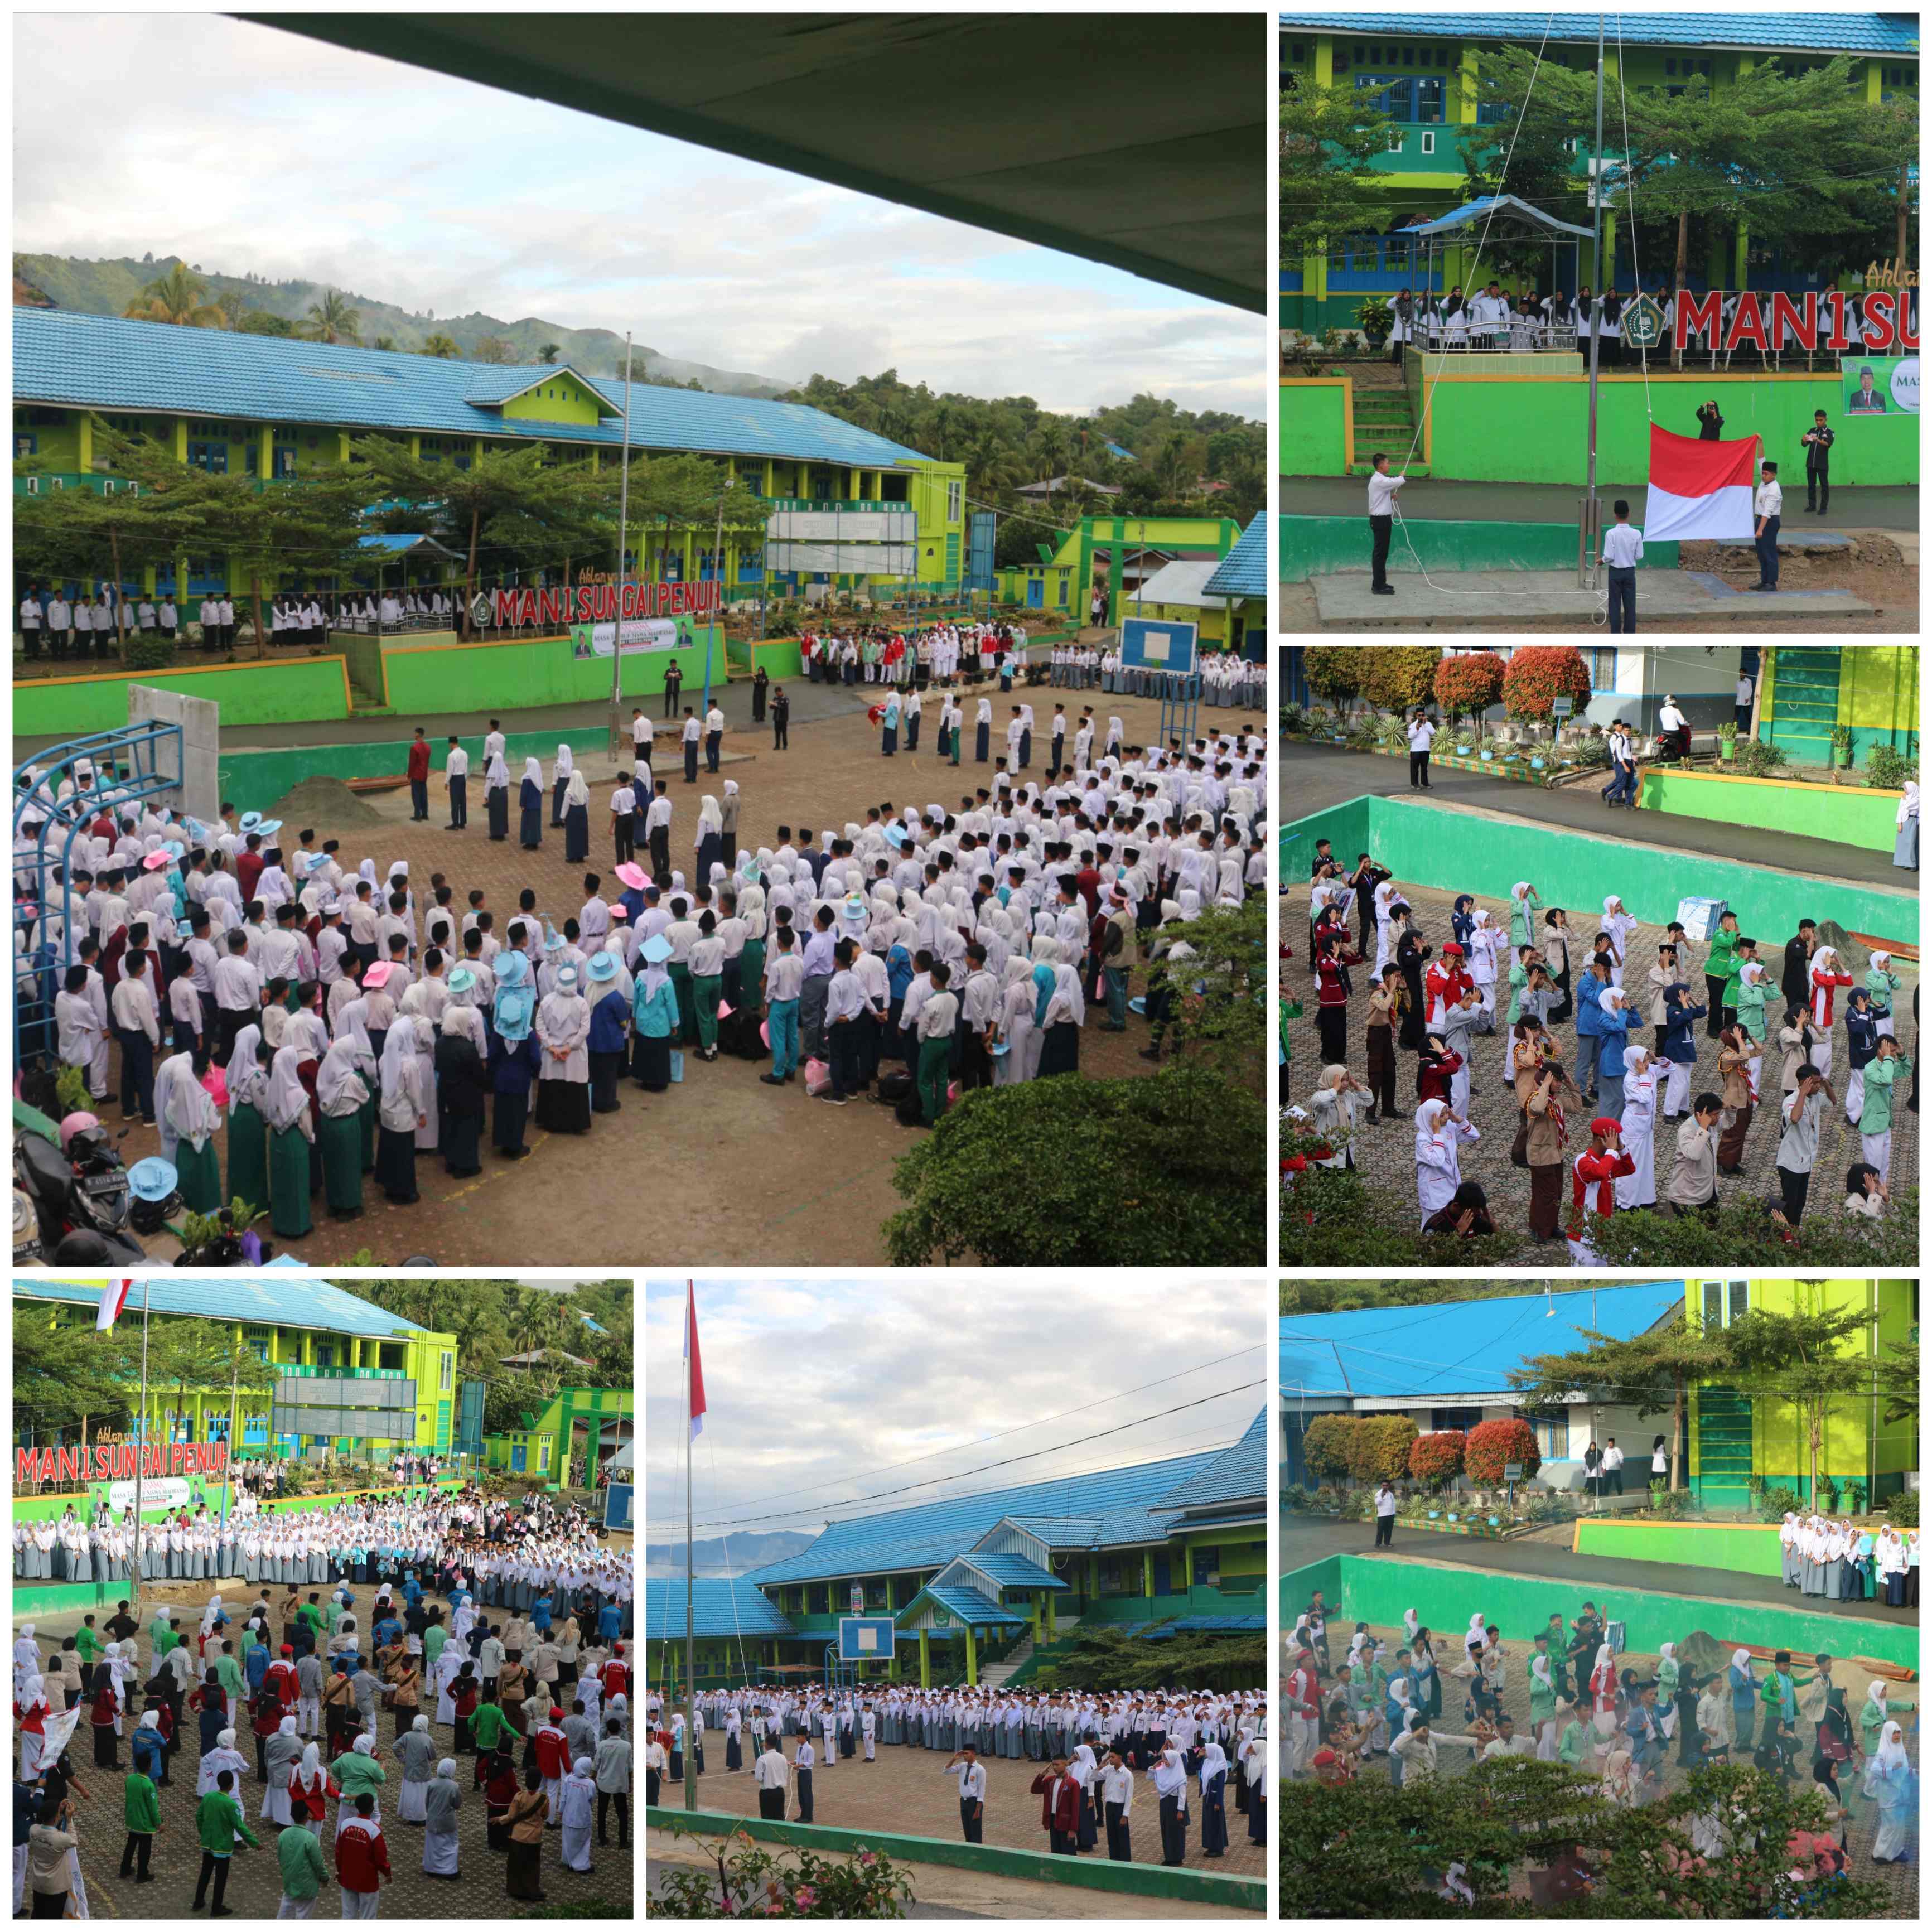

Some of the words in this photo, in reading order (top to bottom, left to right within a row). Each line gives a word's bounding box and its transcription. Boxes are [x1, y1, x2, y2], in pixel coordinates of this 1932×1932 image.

[1865, 258, 1919, 287] Ahla
[1675, 289, 1817, 350] MAN
[1827, 292, 1849, 350] 1
[1863, 292, 1920, 350] SU
[496, 587, 559, 627] MAN
[562, 586, 573, 622] 1
[578, 583, 652, 621] SUNGAI
[657, 579, 721, 618] PENUH
[17, 1447, 78, 1483] MAN
[81, 1446, 91, 1480] 1
[95, 1443, 167, 1479] SUNGAI
